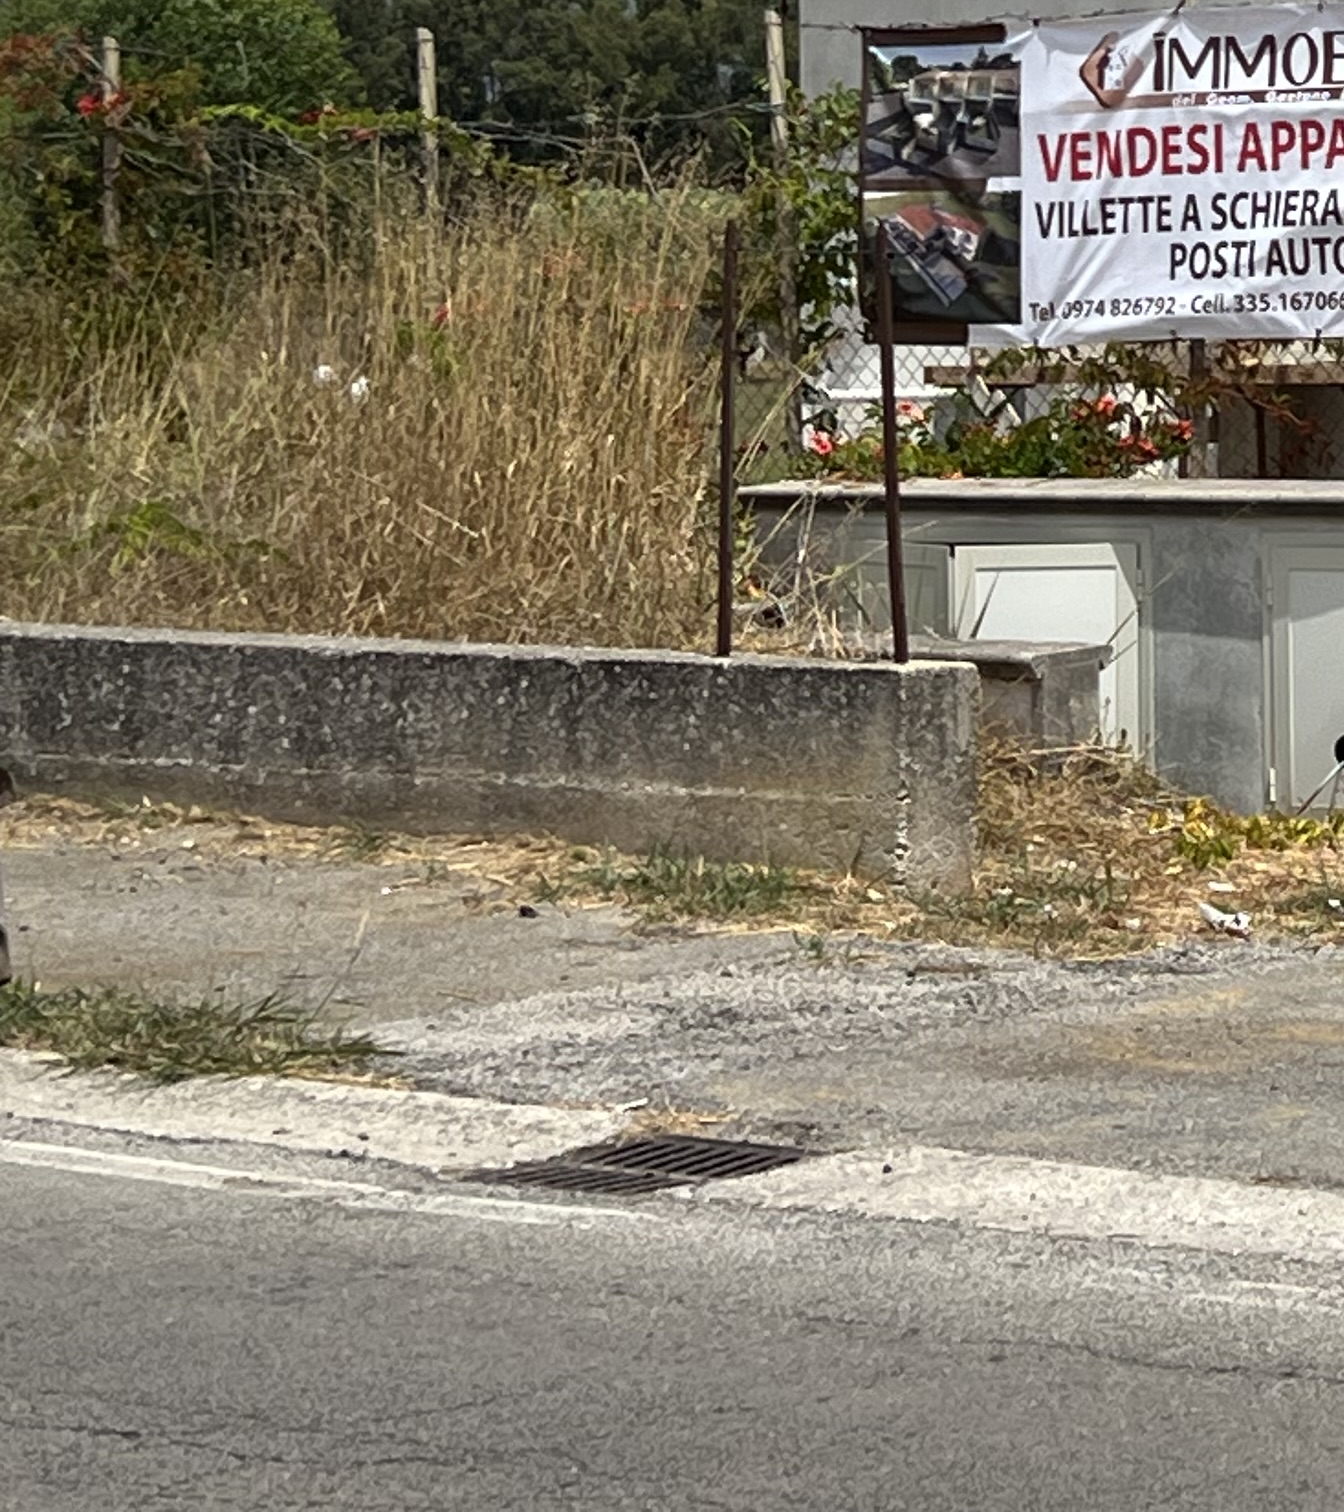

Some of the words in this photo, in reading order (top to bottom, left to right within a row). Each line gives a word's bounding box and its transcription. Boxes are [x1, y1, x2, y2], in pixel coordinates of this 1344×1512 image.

[1037, 124, 1224, 182] VENDESI
[1034, 195, 1172, 239] VILLETTE
[1180, 193, 1202, 232] A
[1210, 189, 1343, 232] SCHIERA
[1169, 240, 1256, 281] POSTI
[1110, 295, 1177, 317] 826792
